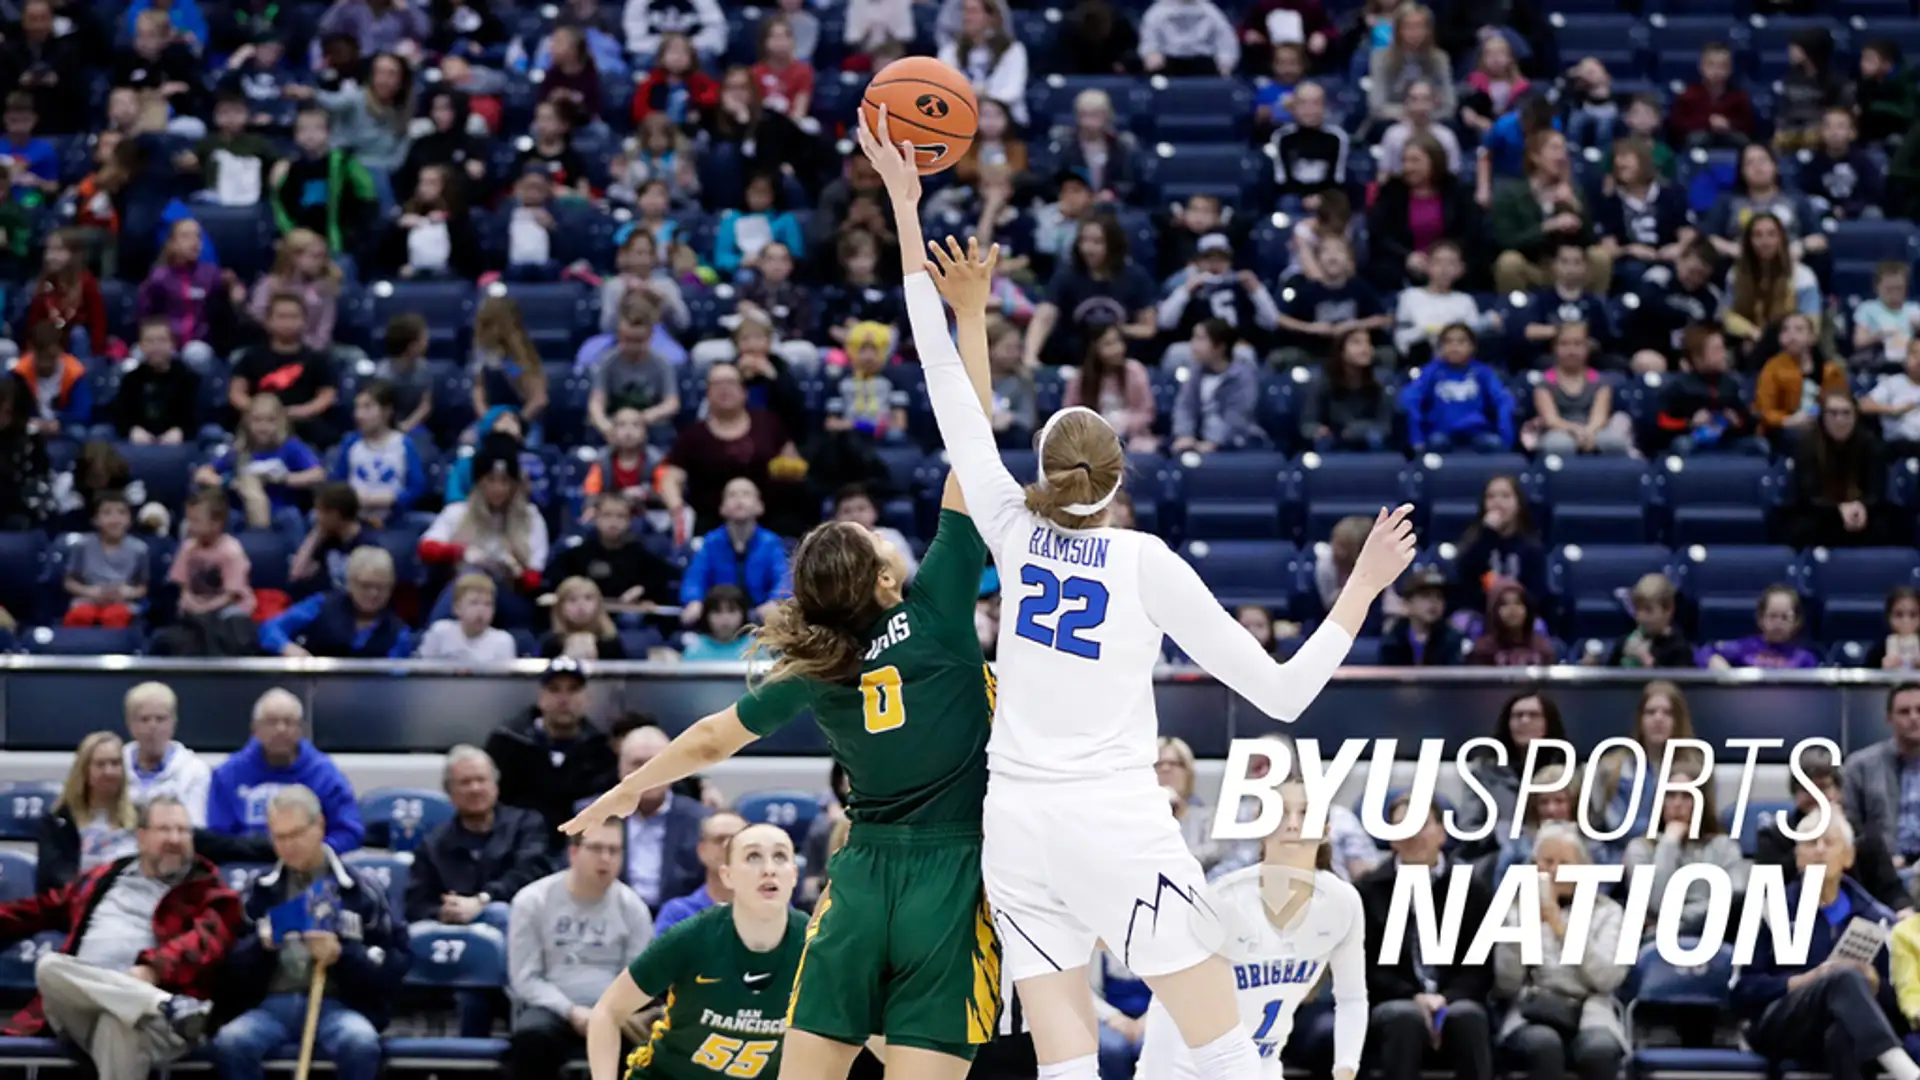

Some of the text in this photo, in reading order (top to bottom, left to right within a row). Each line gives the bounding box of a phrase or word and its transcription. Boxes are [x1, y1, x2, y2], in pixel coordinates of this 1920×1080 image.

[1028, 526, 1111, 568] RAMSON
[1015, 562, 1110, 660] 22
[858, 665, 906, 734] 0
[431, 939, 467, 963] 27
[1252, 999, 1284, 1039] 1
[692, 1032, 778, 1078] 55
